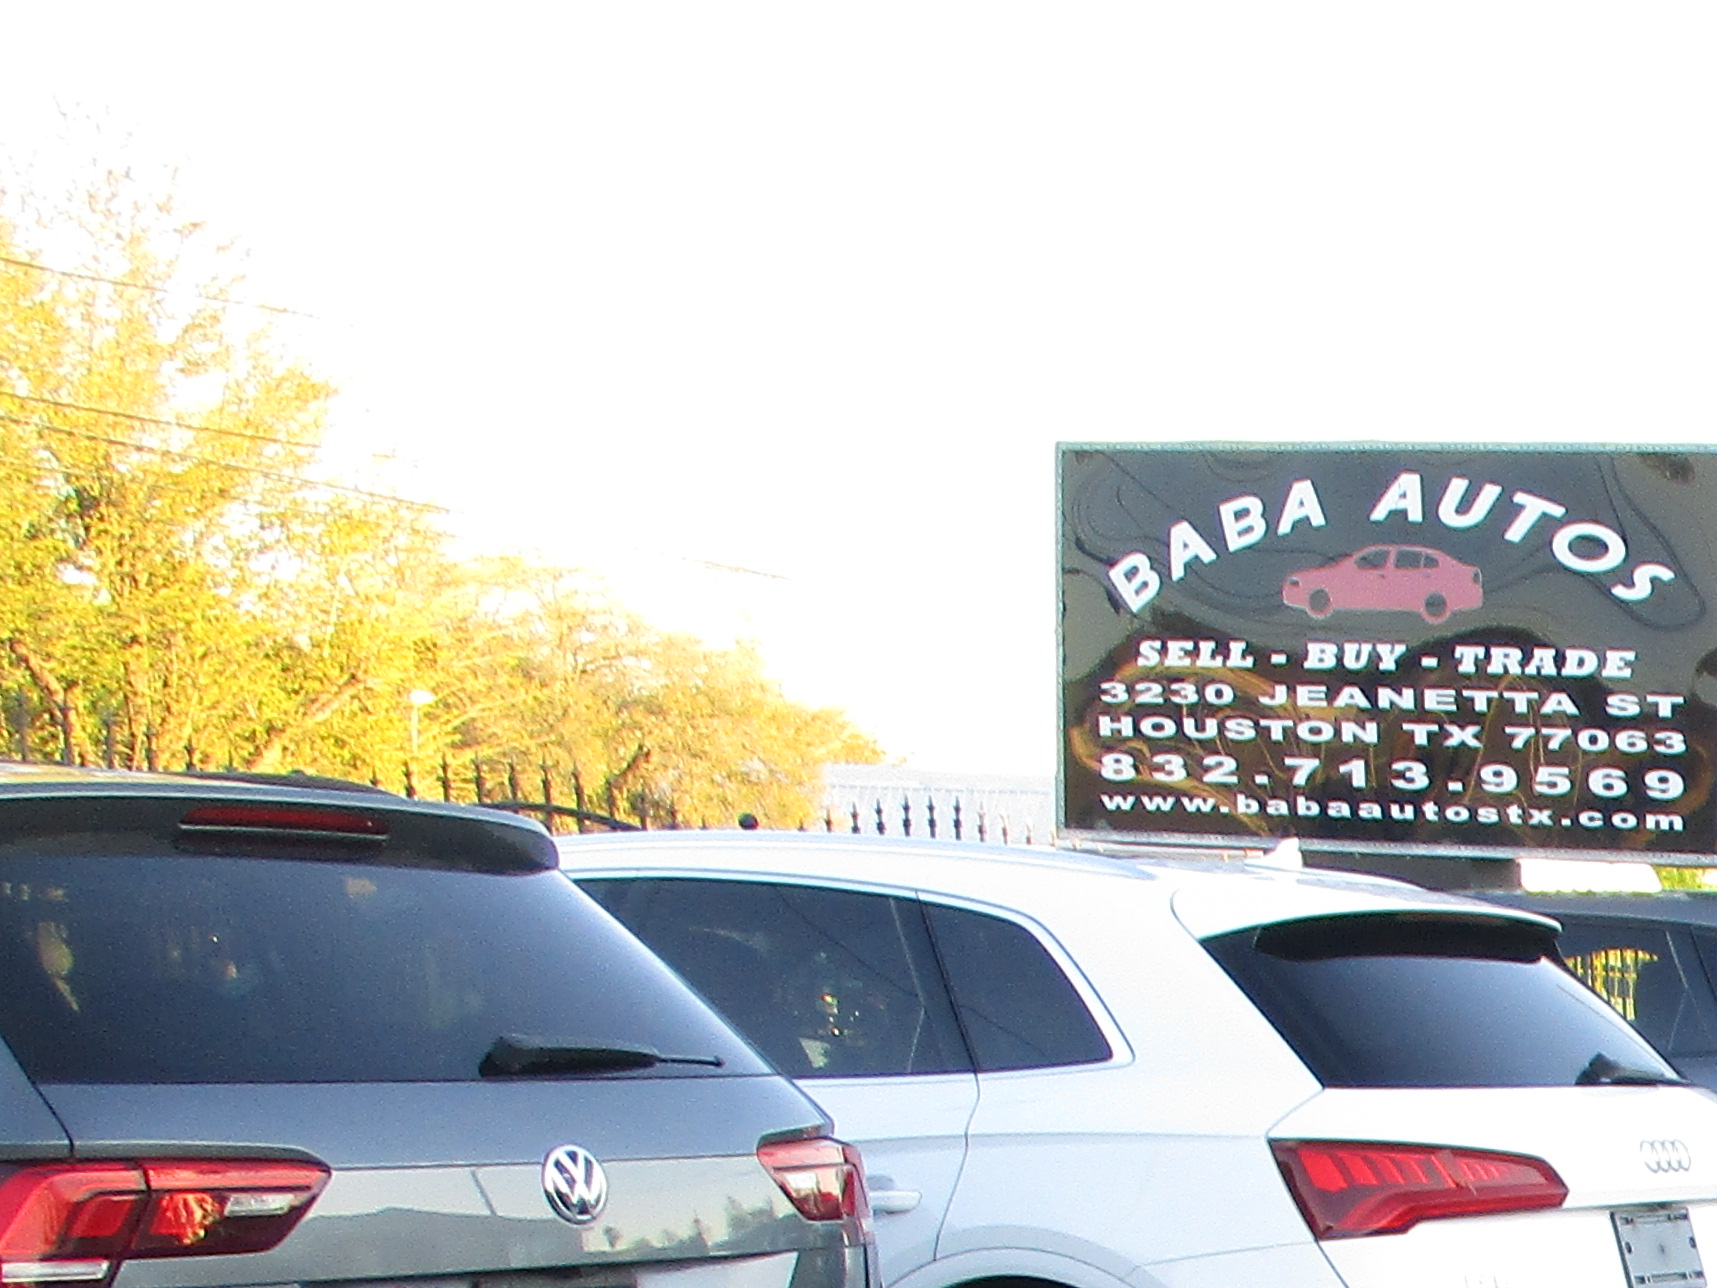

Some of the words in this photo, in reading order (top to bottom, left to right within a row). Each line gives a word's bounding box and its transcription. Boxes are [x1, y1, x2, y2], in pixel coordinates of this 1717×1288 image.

[1108, 478, 1327, 614] BABA
[1369, 471, 1676, 601] AUTOS
[1136, 639, 1255, 668] SELL
[1303, 641, 1408, 671] BUY
[1454, 644, 1637, 679] TRADE
[1099, 680, 1235, 706] 3230
[1257, 683, 1580, 717] JEANETTA
[1604, 693, 1686, 719] ST
[1098, 714, 1379, 744] HOUSTON
[1401, 722, 1484, 749] TX
[1504, 725, 1687, 755] 77063
[1100, 752, 1685, 801] 832.713.9569
[1100, 792, 1684, 832] www.babaautostx.com
